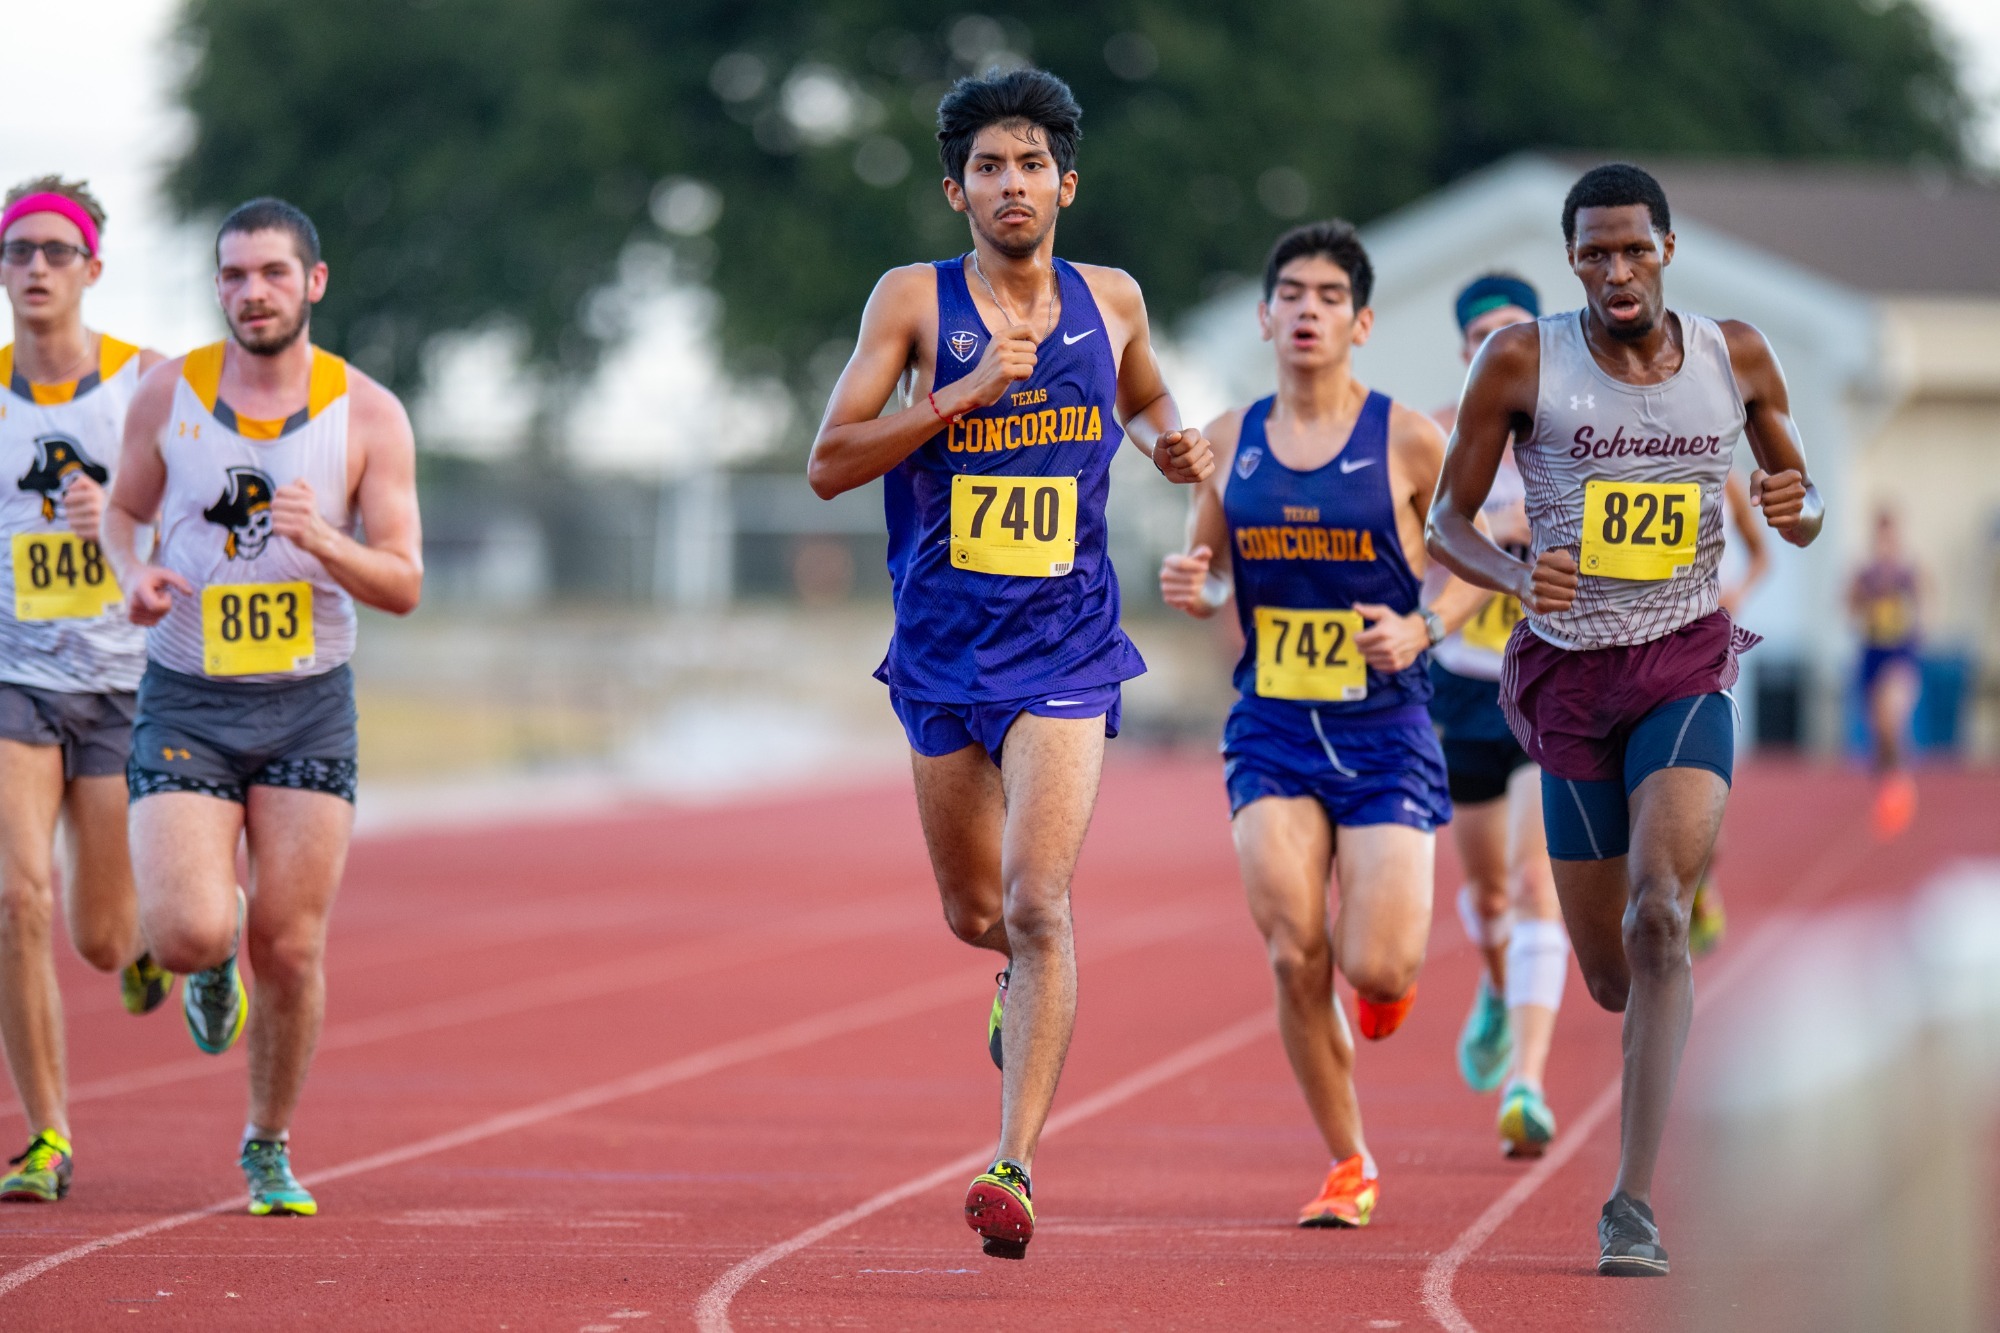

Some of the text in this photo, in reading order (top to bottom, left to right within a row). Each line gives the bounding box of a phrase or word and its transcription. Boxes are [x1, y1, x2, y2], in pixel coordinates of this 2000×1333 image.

[1011, 388, 1048, 407] TEXAS
[948, 406, 1102, 453] CONCORDIA
[1570, 426, 1720, 459] Schreiner
[970, 485, 1059, 542] 740
[1602, 492, 1686, 546] 825
[29, 541, 104, 590] 848
[1236, 525, 1377, 561] CONCORDIA
[221, 592, 298, 642] 863
[1477, 594, 1519, 630] 76
[1272, 618, 1348, 669] 742
